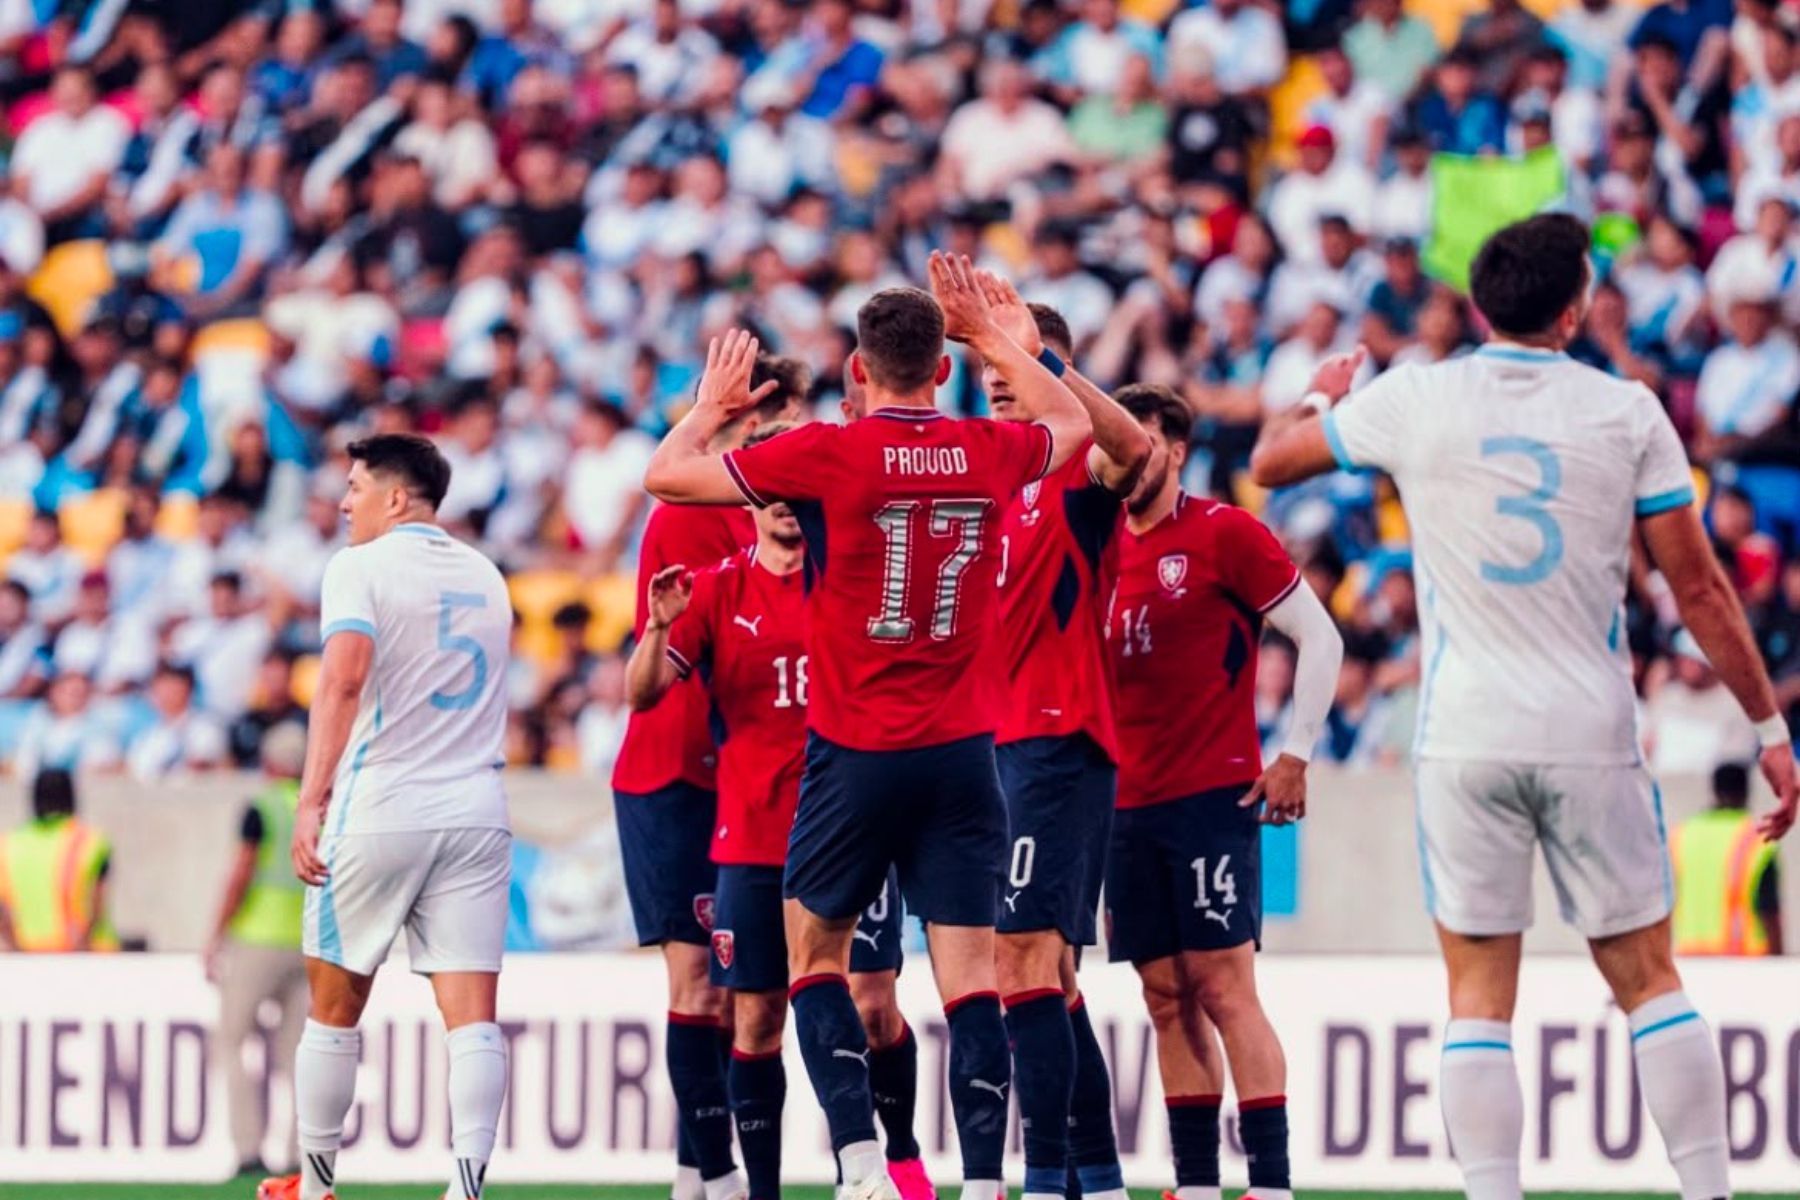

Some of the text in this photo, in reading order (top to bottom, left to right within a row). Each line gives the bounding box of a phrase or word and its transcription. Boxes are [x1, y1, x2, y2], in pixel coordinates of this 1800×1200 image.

[883, 446, 968, 475] PROVOD
[1480, 436, 1564, 586] 3
[867, 498, 996, 643] 17
[1121, 604, 1152, 657] 14
[430, 591, 488, 711] 5
[1190, 854, 1237, 908] 14
[1324, 1025, 1455, 1158] DE
